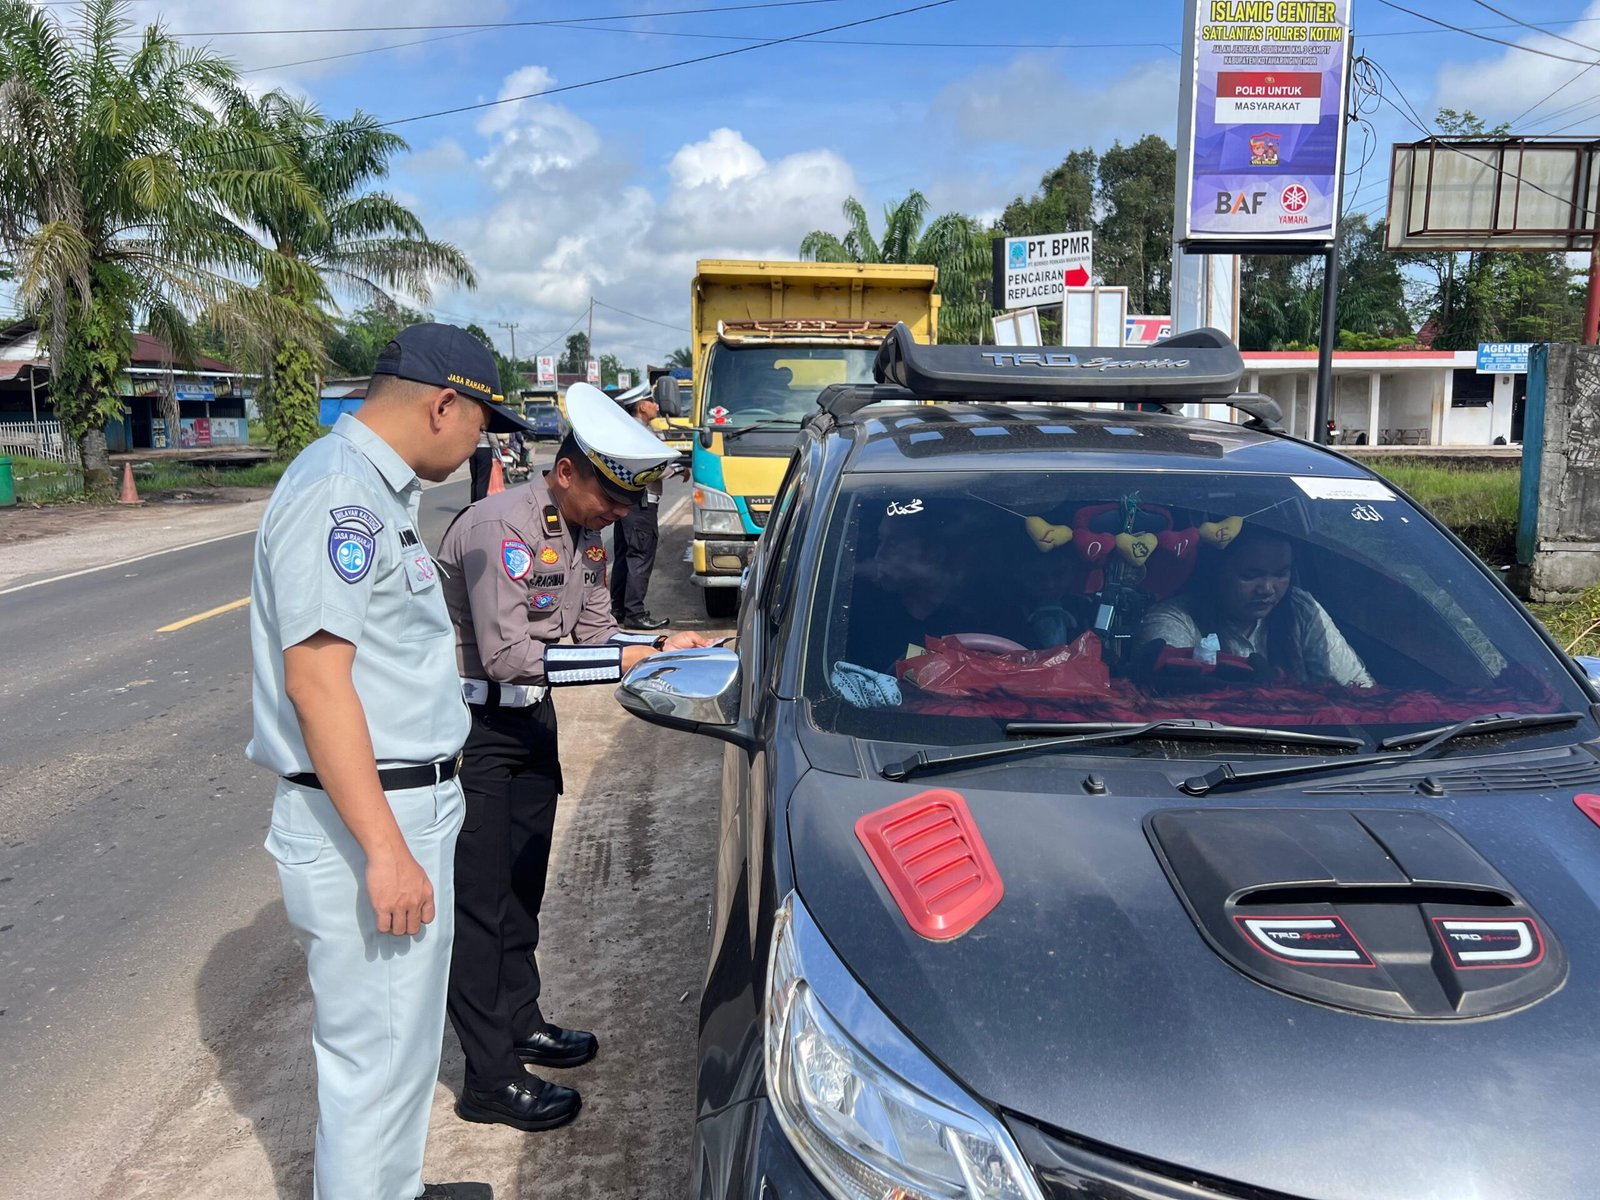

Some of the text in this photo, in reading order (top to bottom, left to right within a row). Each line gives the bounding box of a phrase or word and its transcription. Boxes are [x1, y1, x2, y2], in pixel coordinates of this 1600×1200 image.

[1210, 1, 1336, 23] ISLAMIC CENTER
[1202, 26, 1342, 42] SATLANTAS POLRES KOTIM
[1235, 86, 1302, 96] POLRI UNTUK
[1234, 102, 1301, 111] MASYARAKAT
[1215, 191, 1267, 215] BAF
[1279, 215, 1308, 225] YAMAHA
[1028, 236, 1090, 259] PT. BPMR
[1008, 269, 1064, 286] PENCAIRAN
[1008, 284, 1049, 300] REPLACE
[1483, 344, 1530, 354] AGEN BR
[981, 352, 1078, 368] TRD
[447, 373, 491, 394] JASA RAHARJA
[334, 532, 371, 549] JASA RAHARJA
